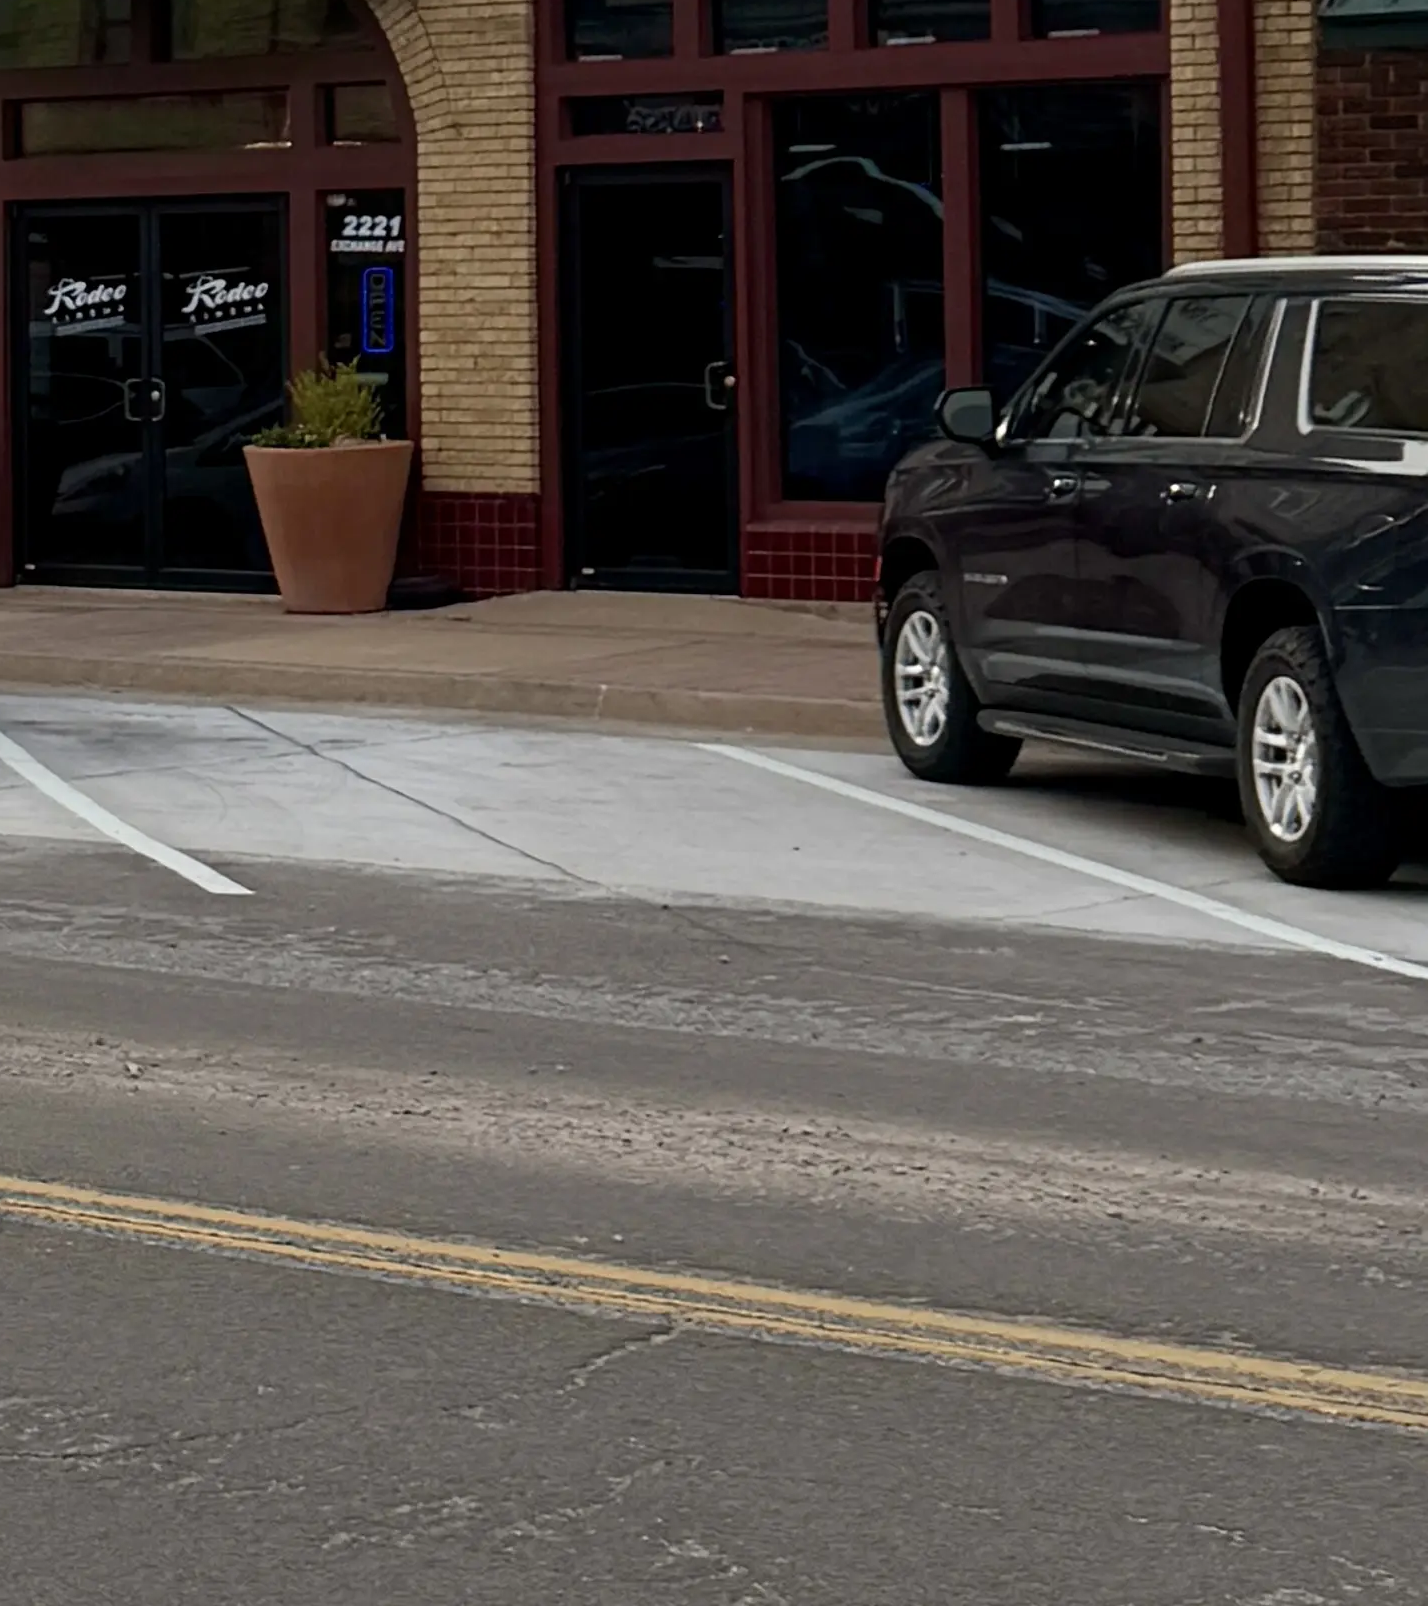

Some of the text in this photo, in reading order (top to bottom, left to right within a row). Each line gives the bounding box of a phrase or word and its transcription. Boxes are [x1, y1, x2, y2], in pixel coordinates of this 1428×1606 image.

[341, 215, 402, 237] 2221
[44, 278, 127, 315] Rodeo
[181, 275, 269, 313] Rodeo
[369, 273, 386, 347] OPEN
